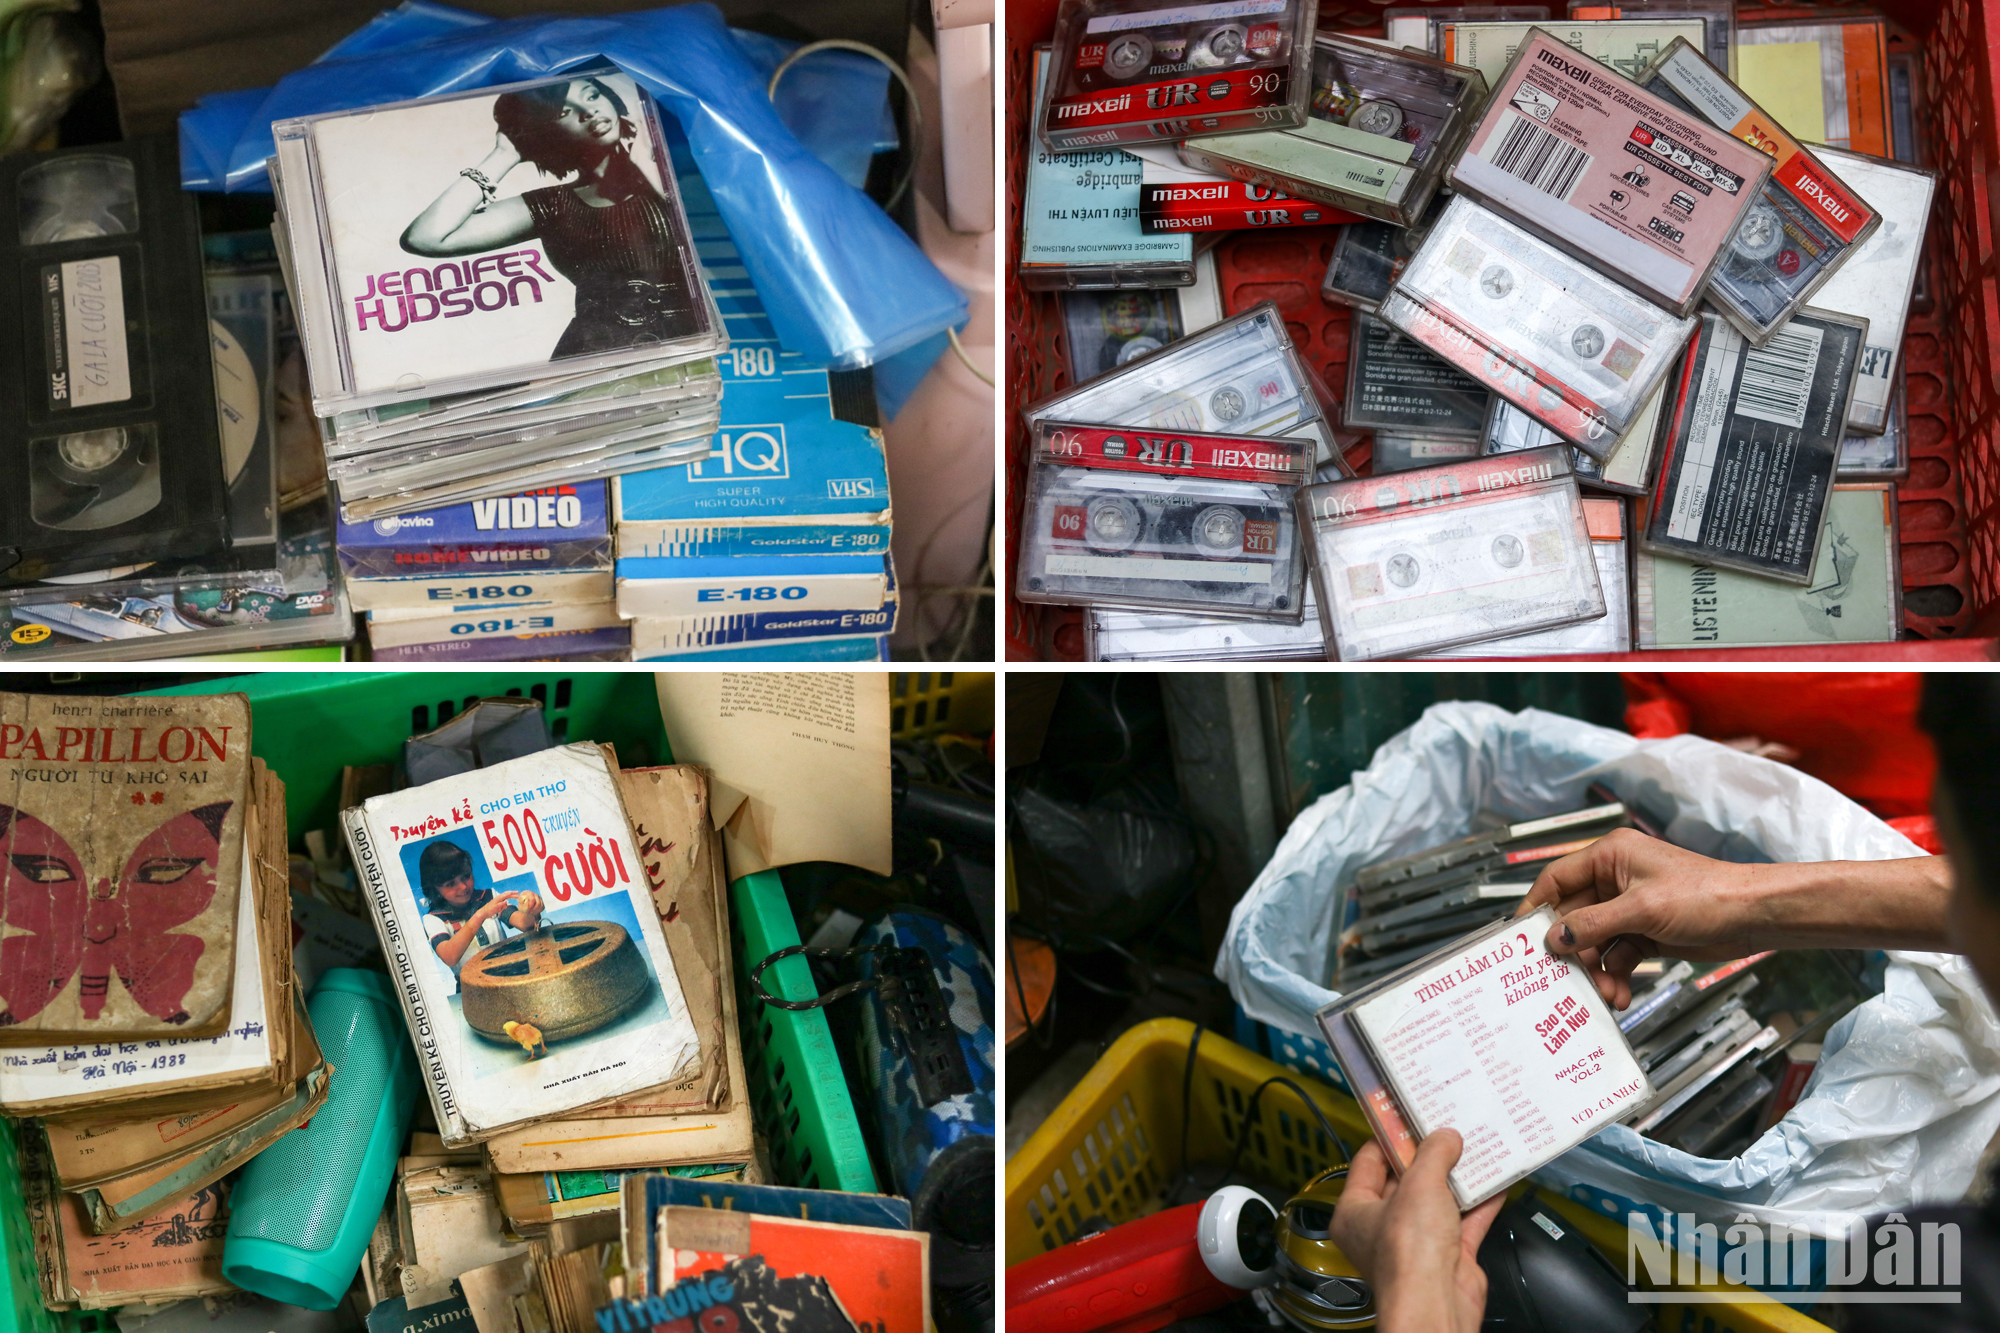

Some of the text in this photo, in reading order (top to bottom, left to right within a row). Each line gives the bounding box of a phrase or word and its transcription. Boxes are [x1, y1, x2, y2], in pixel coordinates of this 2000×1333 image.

[1252, 29, 1272, 43] 90
[1080, 45, 1104, 57] UR
[1082, 73, 1092, 84] A
[1150, 61, 1196, 75] maxell
[1536, 47, 1590, 85] maxell
[1058, 94, 1131, 119] maxell
[1146, 82, 1202, 110] UR
[1249, 73, 1280, 96] 90
[1591, 75, 1702, 140] GREAT FOR EVERYDAY RECORDING
[1552, 117, 1582, 137] CLEANING
[1588, 81, 1718, 157] CLEAR, EXPANSIVE HIGH QUALITY SOUND
[1061, 131, 1119, 148] maxell
[1549, 122, 1588, 147] LEADER TAPE
[1039, 151, 1114, 167] Certificate
[1634, 130, 1735, 190] UR UD XL XL-S MX-S
[1636, 121, 1737, 180] MAXELL CASSETTE GRADE CHART
[1076, 170, 1144, 190] ambridge
[1625, 143, 1710, 194] UR CASSETTE BEST FOR:
[1152, 185, 1229, 201] maxell
[1794, 173, 1850, 223] maxell
[1048, 209, 1067, 219] THI
[1071, 206, 1109, 221] LUYỆN
[1153, 208, 1294, 229] maxell UR
[1598, 202, 1628, 221] PORTABLES
[1661, 202, 1692, 222] CAR STEREO
[1135, 242, 1180, 250] CAMBRIDGE
[1635, 223, 1662, 241] PORTABLE
[1079, 243, 1132, 252] EXAMINATIONS
[354, 249, 556, 302] JENNIFER
[356, 275, 543, 332] HUDSON
[82, 340, 109, 387] GALA
[717, 346, 776, 377] -180
[1402, 298, 1474, 351] maxell
[1480, 341, 1541, 401] UR
[1570, 406, 1609, 442] 90
[52, 372, 67, 400] SKC
[1821, 336, 1850, 436] Hitachi Maxell, Ltd. Tokyo Japan
[693, 431, 781, 476] HQ
[1050, 430, 1291, 472] maxell UR 90
[695, 497, 785, 508] HIGH QUALITY
[717, 486, 761, 497] SUPER
[831, 481, 872, 496] VHS
[1323, 462, 1552, 523] maxell UR 90
[1706, 458, 1734, 545] Great for everyday recording
[471, 495, 581, 531] VIDEO
[1059, 513, 1080, 531] 90
[751, 533, 880, 548] GoldStar E-180
[1245, 535, 1274, 552] UR
[295, 594, 325, 606] DVD
[427, 585, 533, 601] E-180
[697, 586, 808, 603] E-180
[450, 616, 554, 635] E-180
[764, 612, 887, 630] GoldStar E-180
[52, 702, 92, 717] henri
[0, 723, 233, 764] PAPILLON
[10, 766, 77, 783] NGƯỜI
[179, 770, 208, 784] SAI
[390, 815, 449, 843] Truyện
[479, 796, 512, 815] CHO
[513, 789, 535, 805] EM
[536, 779, 568, 798] THƠ
[353, 825, 374, 861] CƯỜI
[482, 807, 547, 872] 500
[544, 827, 631, 903] CƯỜI
[365, 861, 392, 918] TRUYỆN
[383, 918, 401, 943] 500
[393, 949, 414, 983] THƠ
[1414, 975, 1454, 1004] TÌNH
[1452, 955, 1492, 984] LẦM
[1515, 932, 1535, 957] 2
[1500, 951, 1562, 990] Tình yêu
[404, 981, 421, 1004] EM
[1504, 960, 1571, 1008] không lời
[411, 1005, 431, 1037] CHO
[1535, 995, 1577, 1039] Sao Em
[1543, 1004, 1591, 1056] Làm Ngơ
[4, 1054, 28, 1066] Nhà
[32, 1049, 57, 1065] xuất
[82, 1053, 186, 1081] Hà Nội 1988
[1555, 1046, 1606, 1082] NHẠC TRẺ
[1569, 1063, 1602, 1085] VOL:2
[429, 1059, 458, 1118] TRUYỆN
[1571, 1078, 1642, 1126] VCD CA NHẠC
[404, 1268, 417, 1295] 6933
